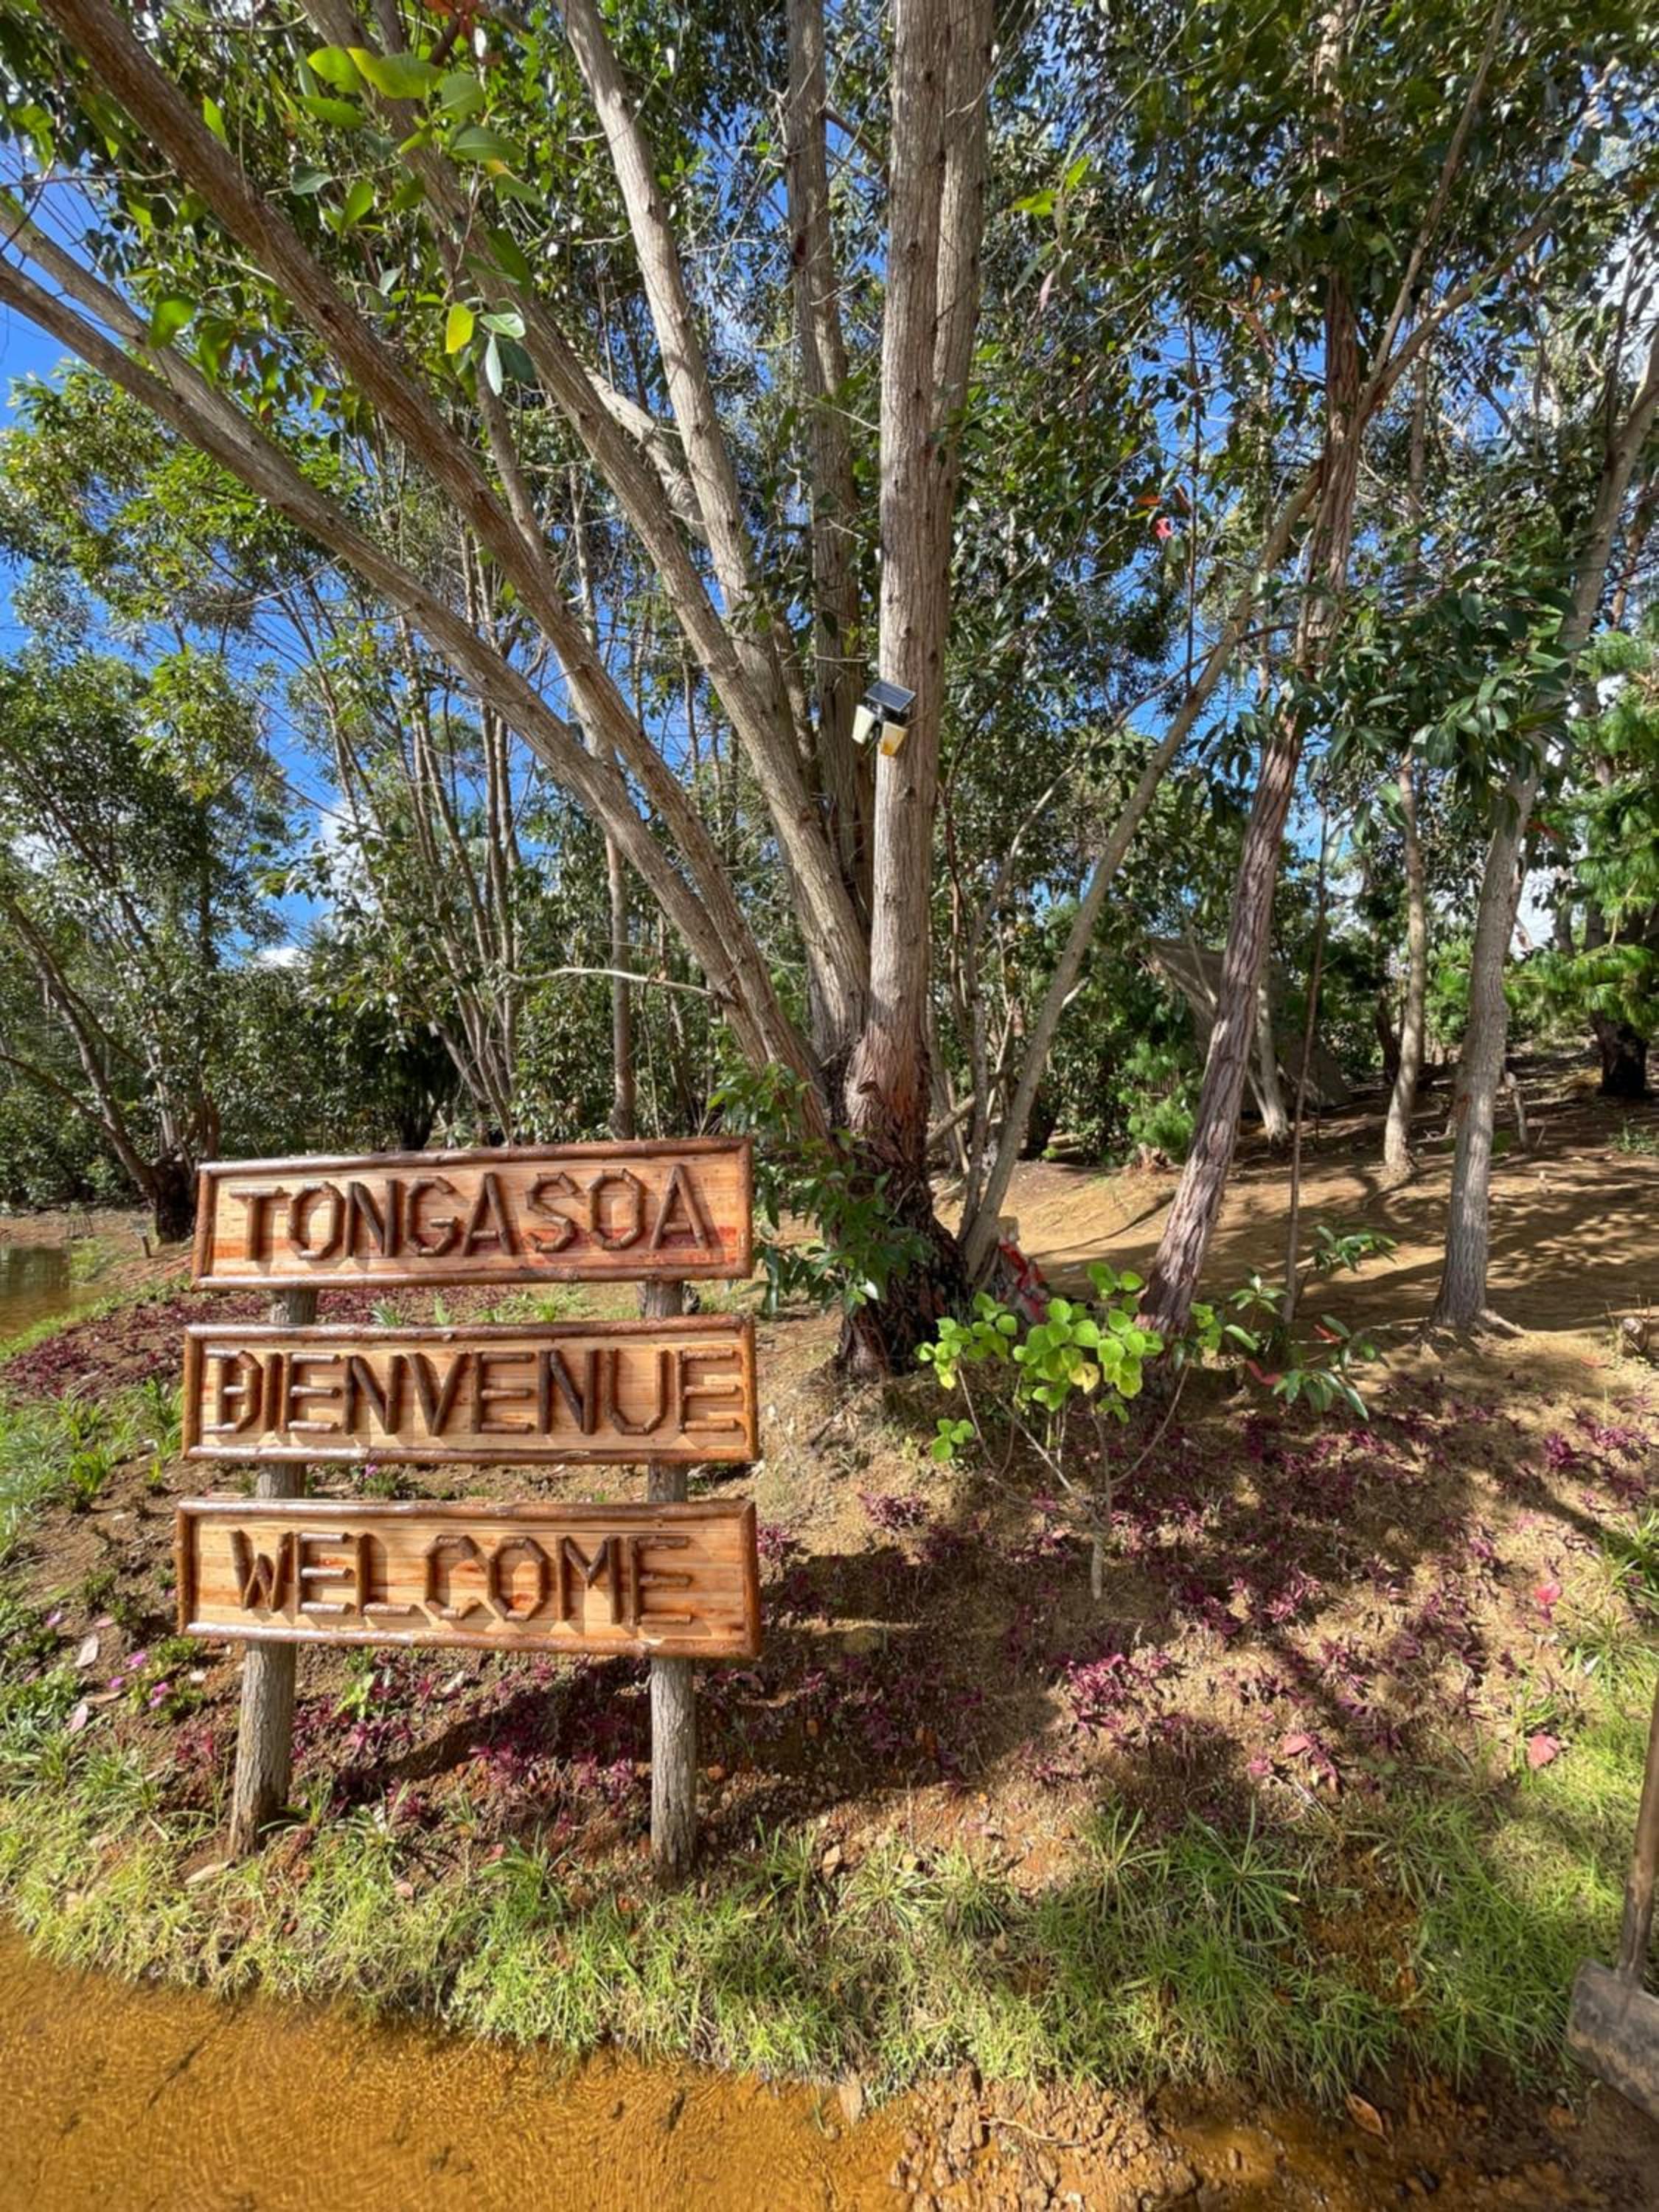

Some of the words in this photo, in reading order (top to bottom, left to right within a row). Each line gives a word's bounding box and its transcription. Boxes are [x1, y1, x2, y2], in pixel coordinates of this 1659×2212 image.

[229, 1163, 712, 1262] TONGASOA
[203, 1349, 739, 1436] BIENVENUE
[229, 1529, 692, 1625] WELCOME
